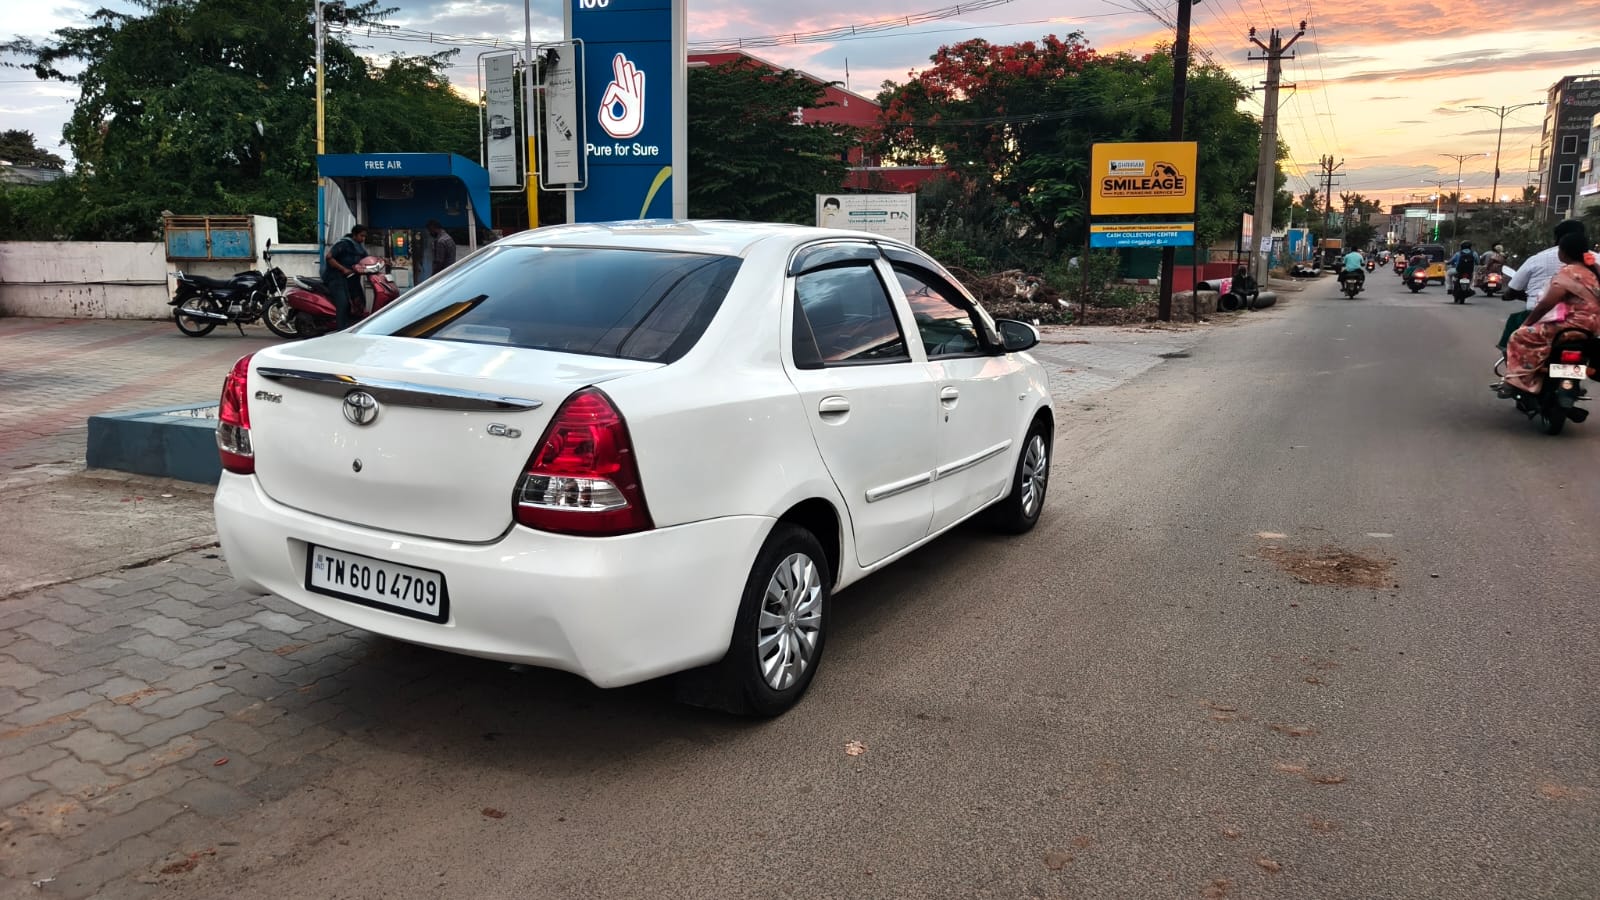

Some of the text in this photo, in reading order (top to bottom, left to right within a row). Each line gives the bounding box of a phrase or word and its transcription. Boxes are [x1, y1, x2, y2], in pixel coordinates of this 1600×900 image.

[586, 143, 659, 156] Pure for Sure
[364, 160, 402, 170] FREE AIR
[1104, 178, 1184, 190] SMILEAGE
[487, 422, 522, 438] GD
[325, 556, 437, 606] TN 60 Q 4709
